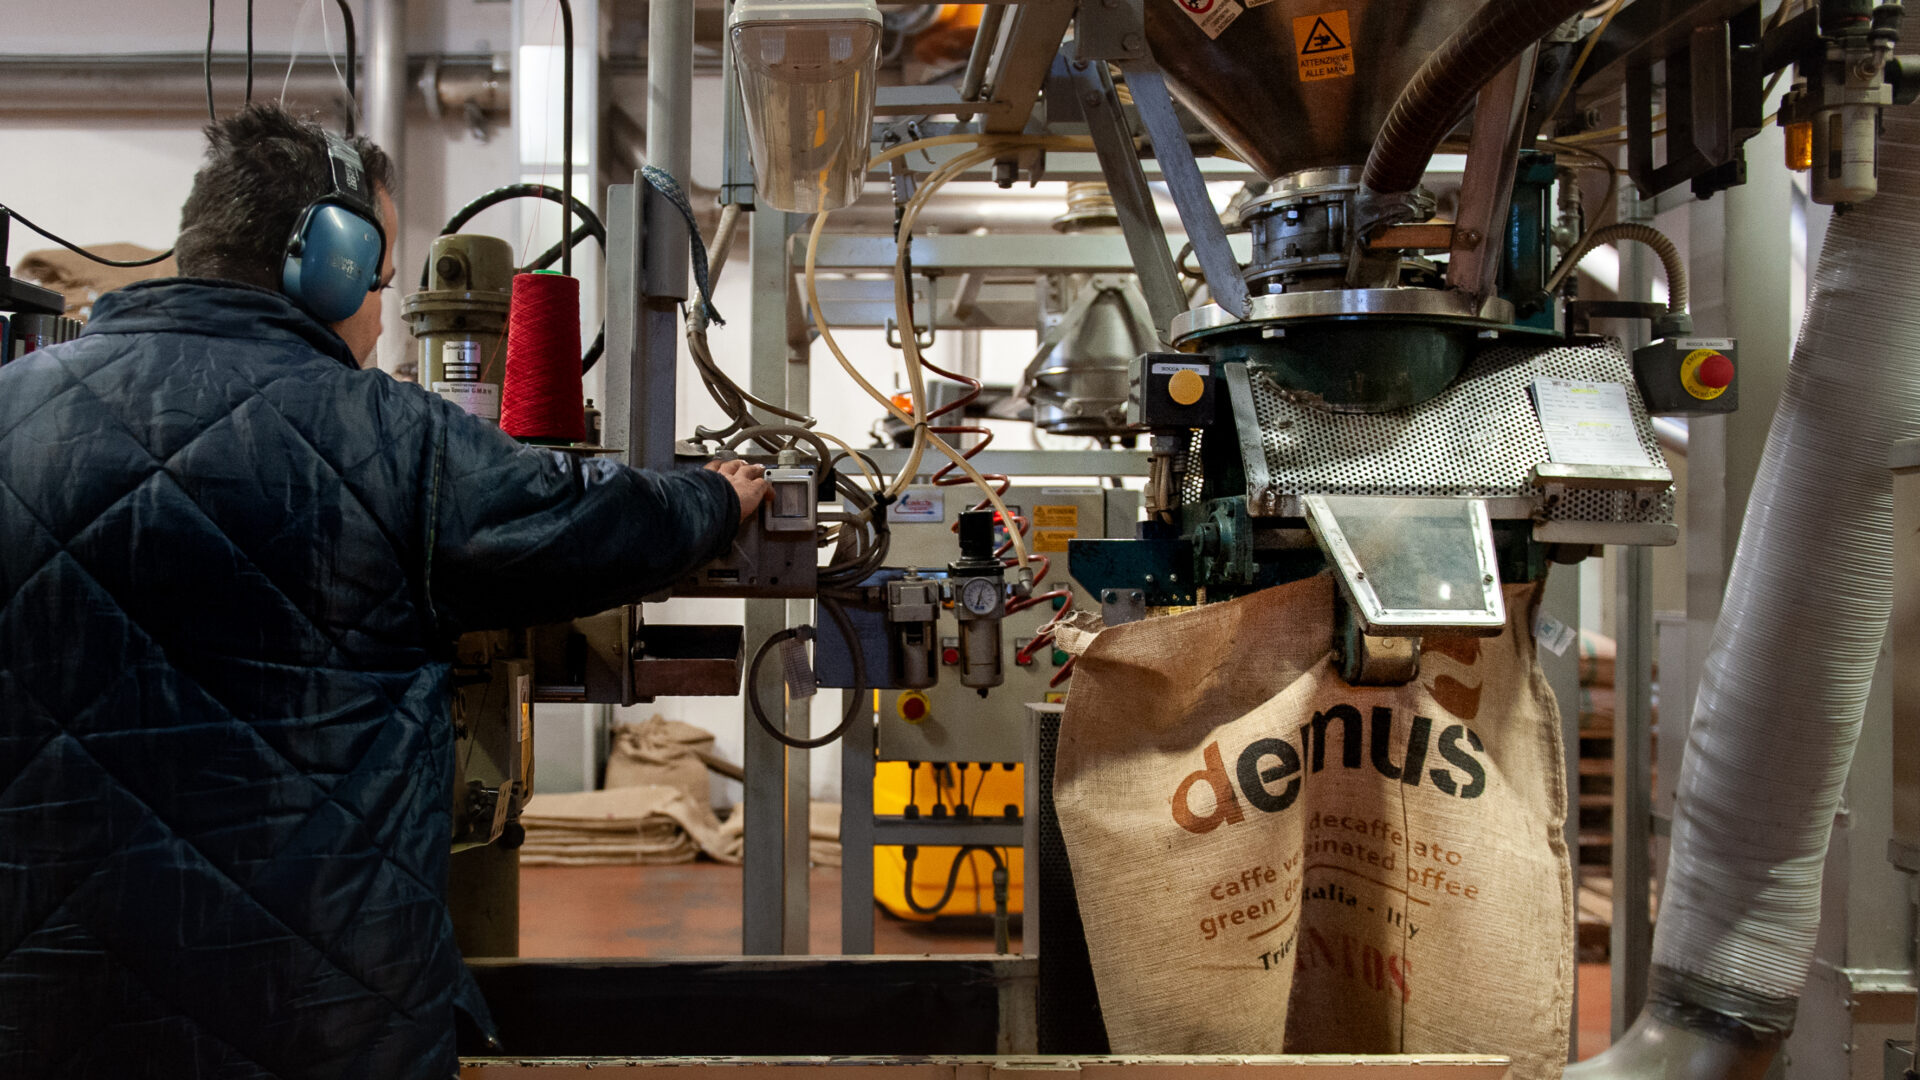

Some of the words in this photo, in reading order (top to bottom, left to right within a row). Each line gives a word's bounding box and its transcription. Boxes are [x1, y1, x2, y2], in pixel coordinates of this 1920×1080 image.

[1305, 68, 1325, 77] ALLE
[1210, 866, 1277, 901] caffè
[1309, 811, 1462, 866] decaffeato
[1200, 896, 1276, 940] green
[1406, 867, 1479, 900] offee
